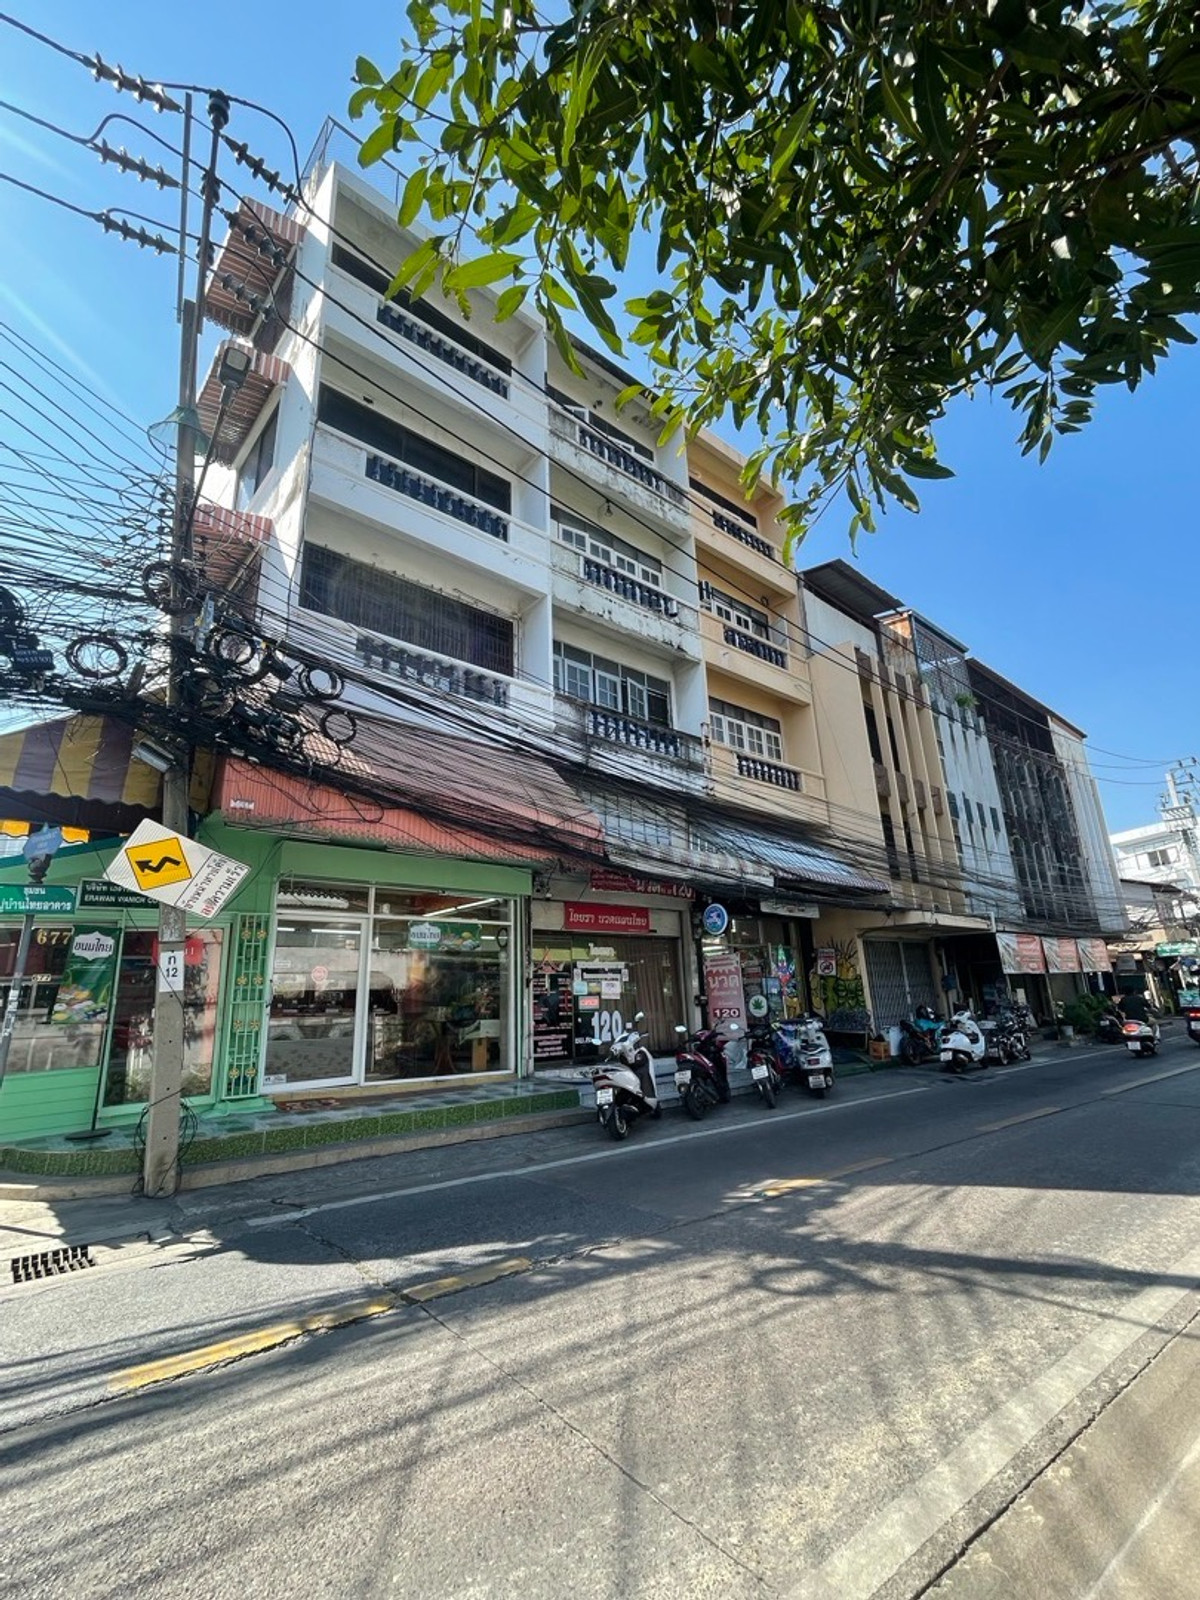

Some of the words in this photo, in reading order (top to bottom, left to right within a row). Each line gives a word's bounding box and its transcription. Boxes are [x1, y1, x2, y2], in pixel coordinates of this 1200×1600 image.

[37, 929, 71, 945] 677
[74, 937, 113, 952] ขนมไทย
[165, 967, 178, 978] 12
[707, 974, 740, 989] นวด
[714, 1008, 739, 1017] 120
[591, 1010, 622, 1043] 120
